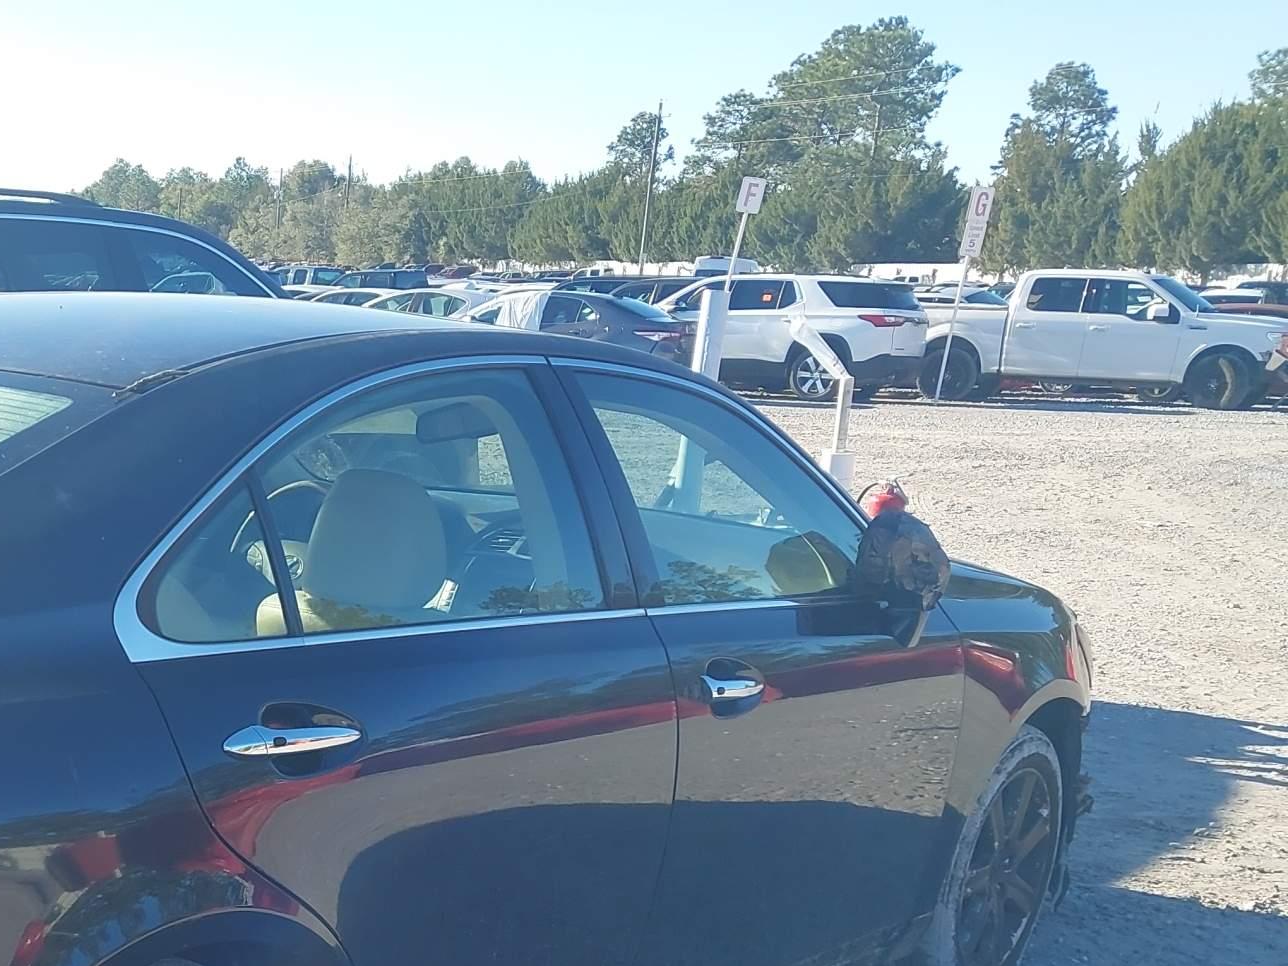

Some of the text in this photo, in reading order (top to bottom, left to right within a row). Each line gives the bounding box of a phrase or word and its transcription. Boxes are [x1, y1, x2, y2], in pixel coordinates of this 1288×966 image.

[743, 182, 760, 207] F
[975, 191, 989, 216] G
[968, 238, 976, 248] 5
